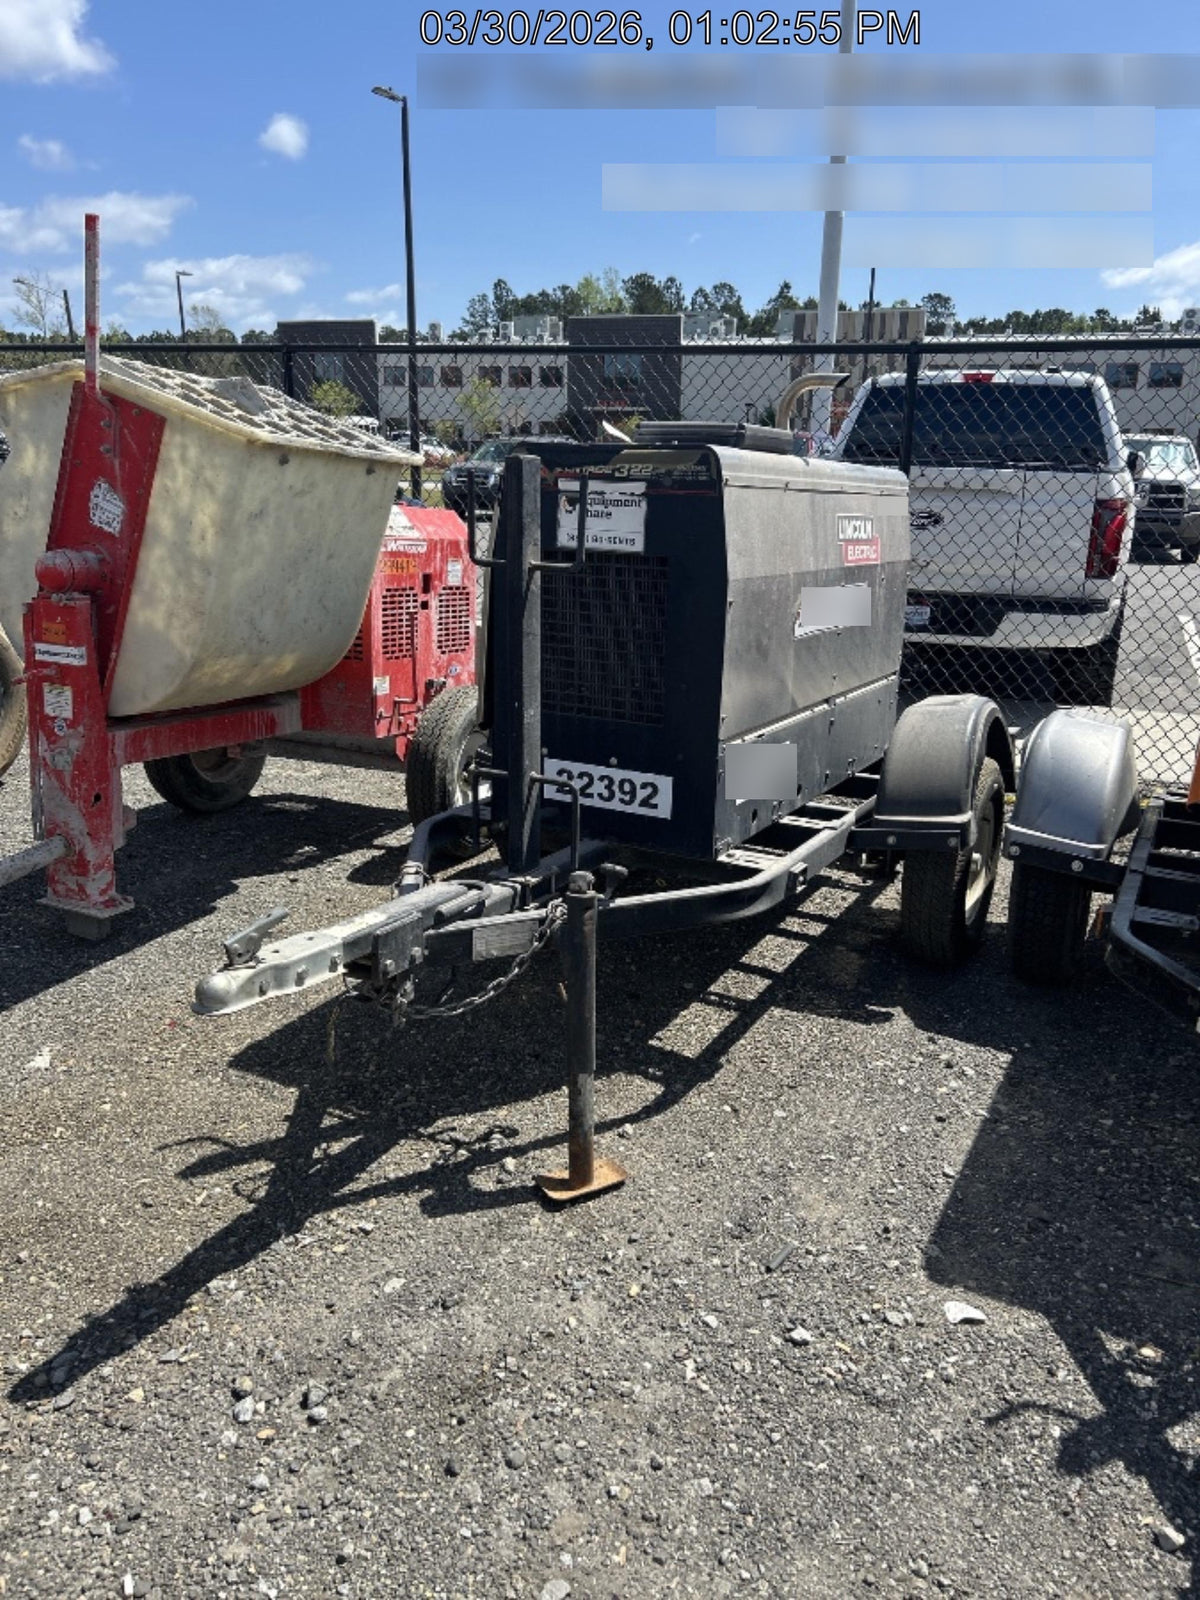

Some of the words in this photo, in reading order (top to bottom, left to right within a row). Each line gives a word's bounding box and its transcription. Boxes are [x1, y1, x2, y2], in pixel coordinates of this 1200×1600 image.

[614, 463, 654, 478] 322
[584, 494, 643, 510] quipment
[584, 508, 613, 520] hare
[838, 518, 873, 540] LINCOLN
[847, 544, 878, 561] ELECTRIC
[554, 767, 660, 811] 22392
